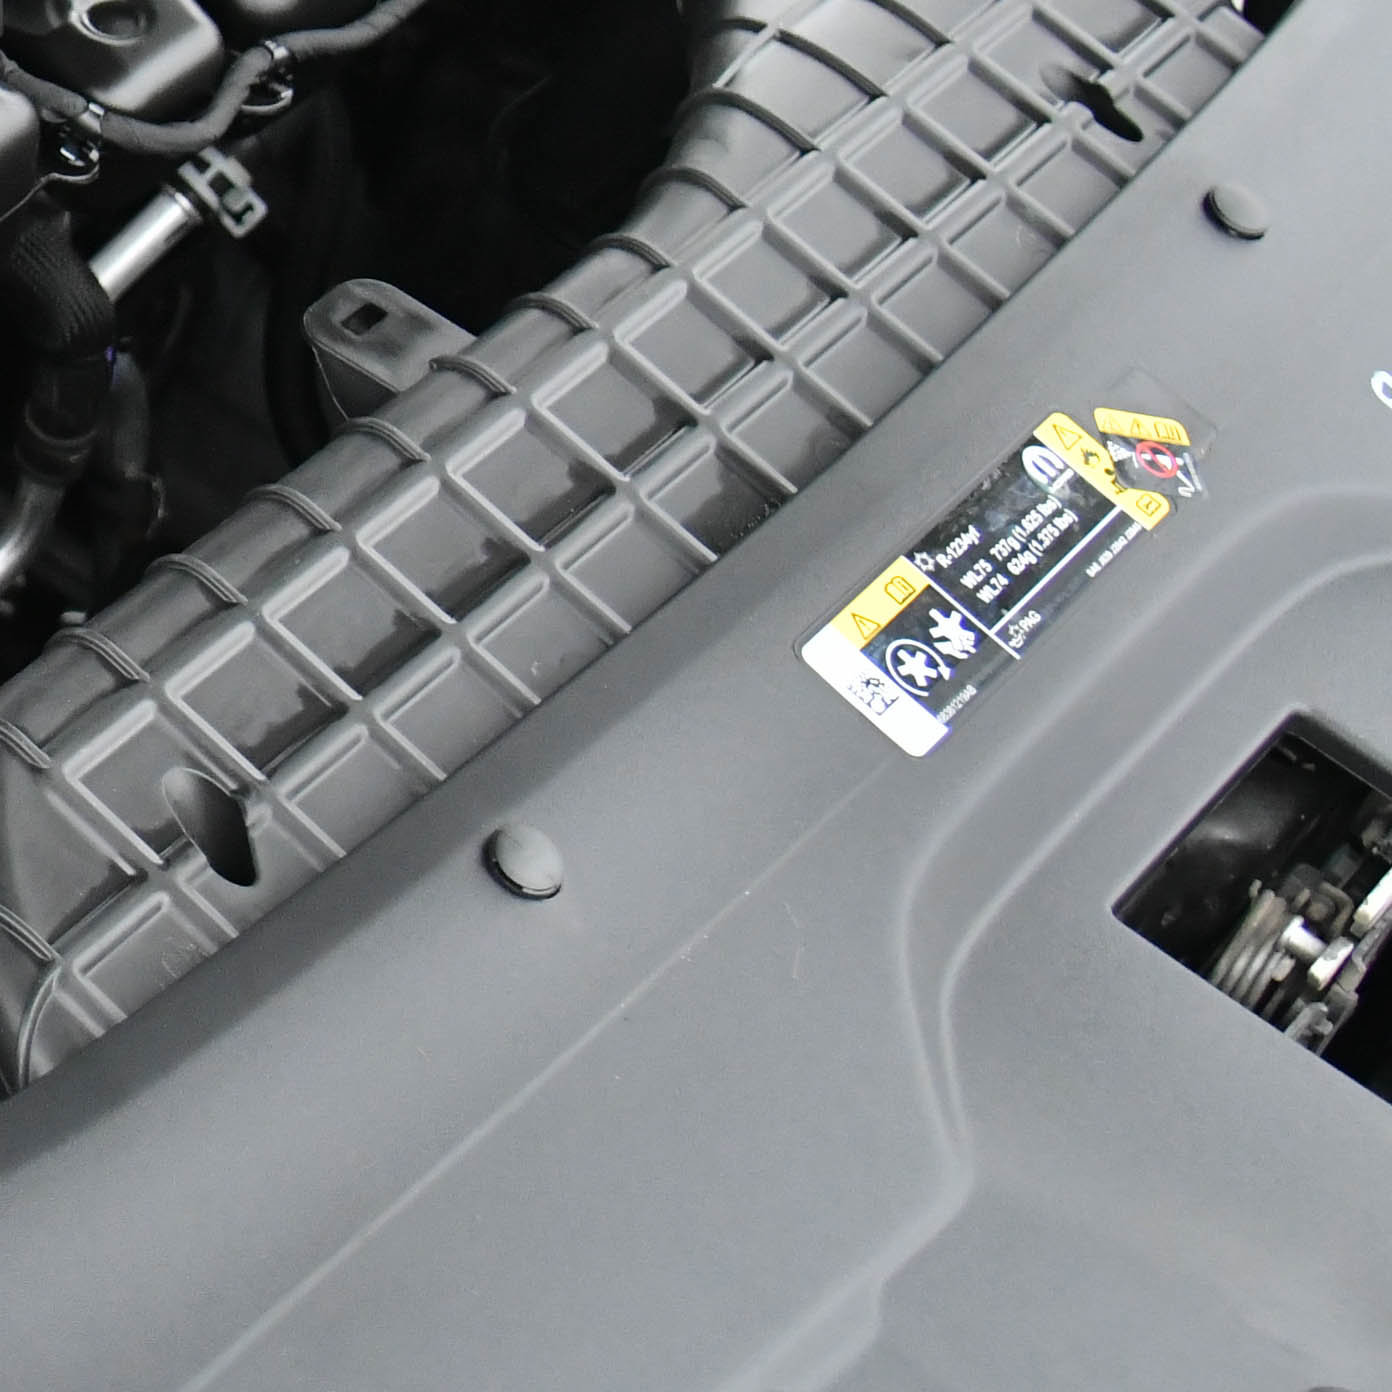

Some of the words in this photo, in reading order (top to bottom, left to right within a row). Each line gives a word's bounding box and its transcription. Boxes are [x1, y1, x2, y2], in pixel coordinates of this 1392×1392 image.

[960, 558, 992, 589] WL75
[990, 535, 1022, 562] 737g
[976, 572, 1009, 604] WL74
[1006, 550, 1038, 576] 624g
[1018, 609, 1043, 633] PAG
